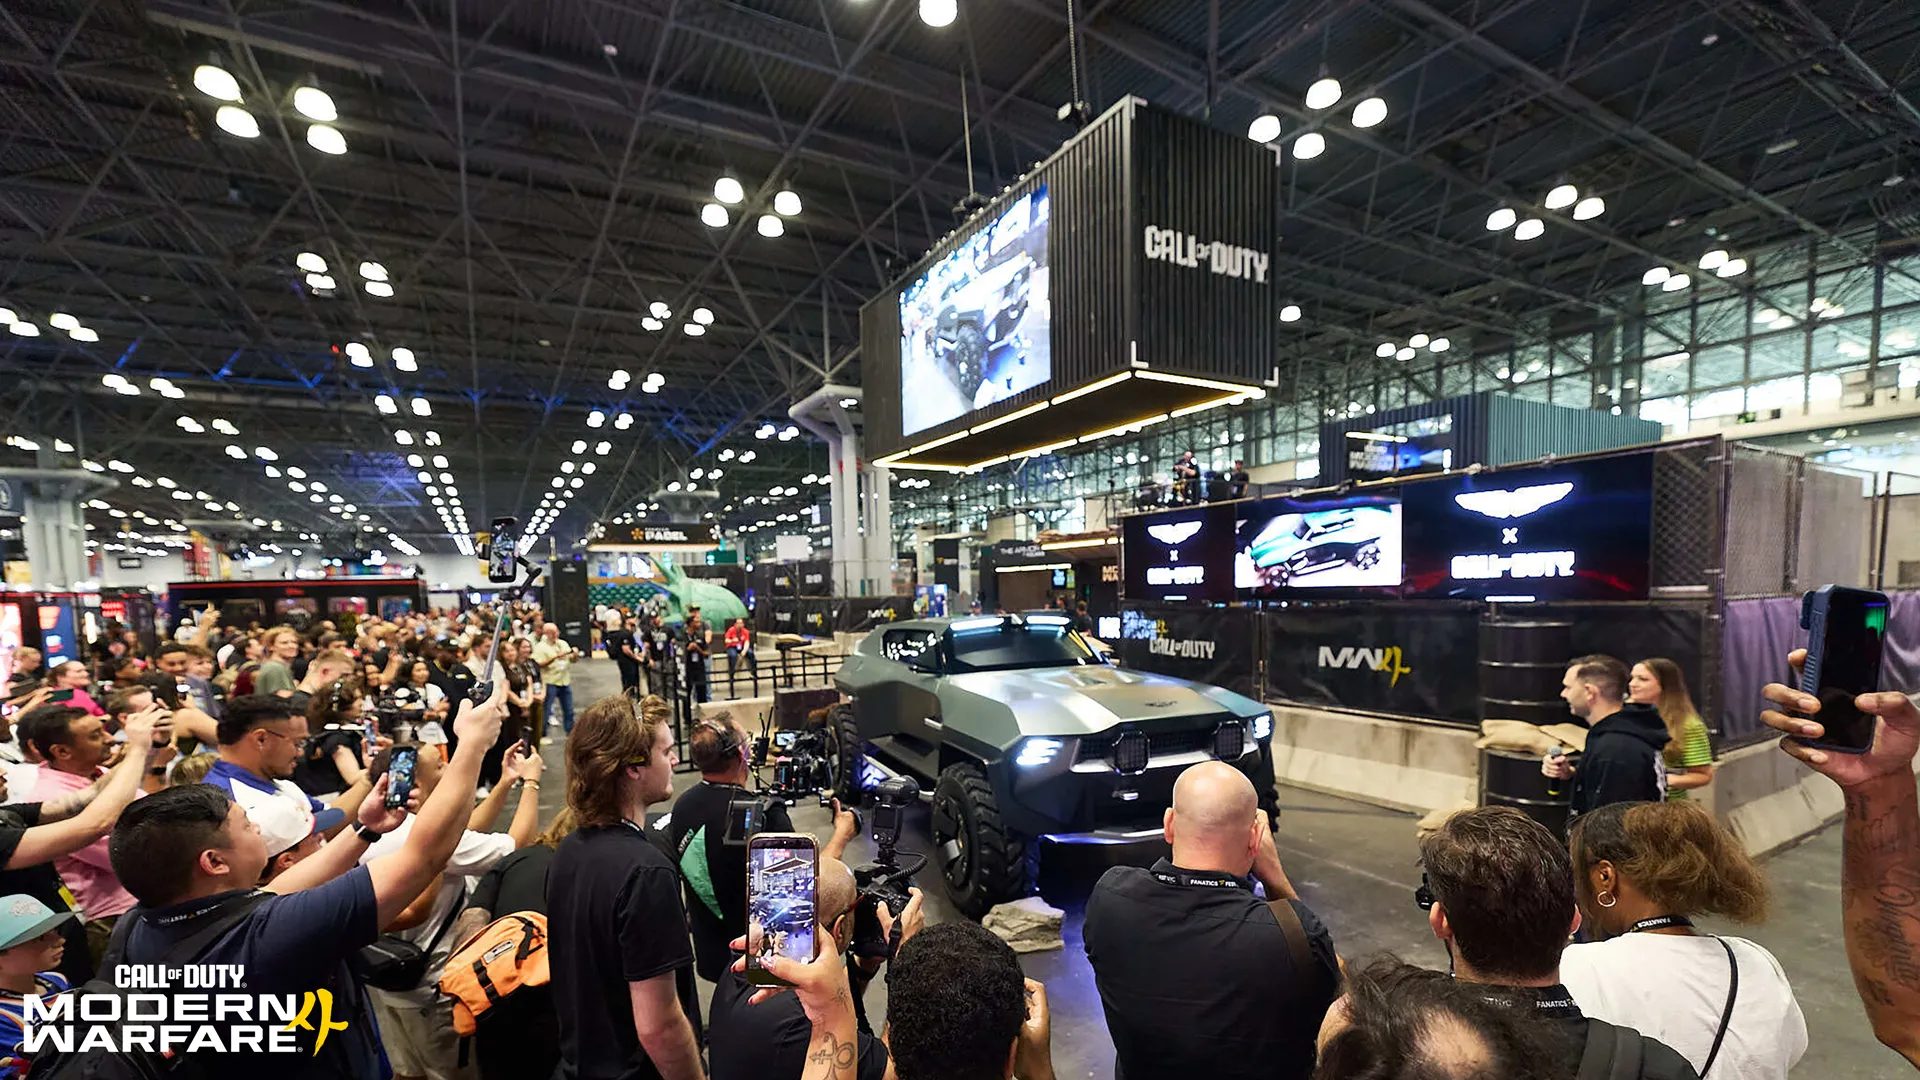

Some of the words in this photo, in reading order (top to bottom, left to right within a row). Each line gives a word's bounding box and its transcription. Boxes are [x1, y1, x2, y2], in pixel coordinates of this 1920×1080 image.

[1145, 225, 1198, 268] CALL
[1211, 241, 1268, 283] DUTY
[1149, 638, 1176, 656] CALL
[1181, 640, 1215, 659] DUTY
[1190, 879, 1218, 887] FANATICS
[1536, 1000, 1568, 1008] FANATICS
